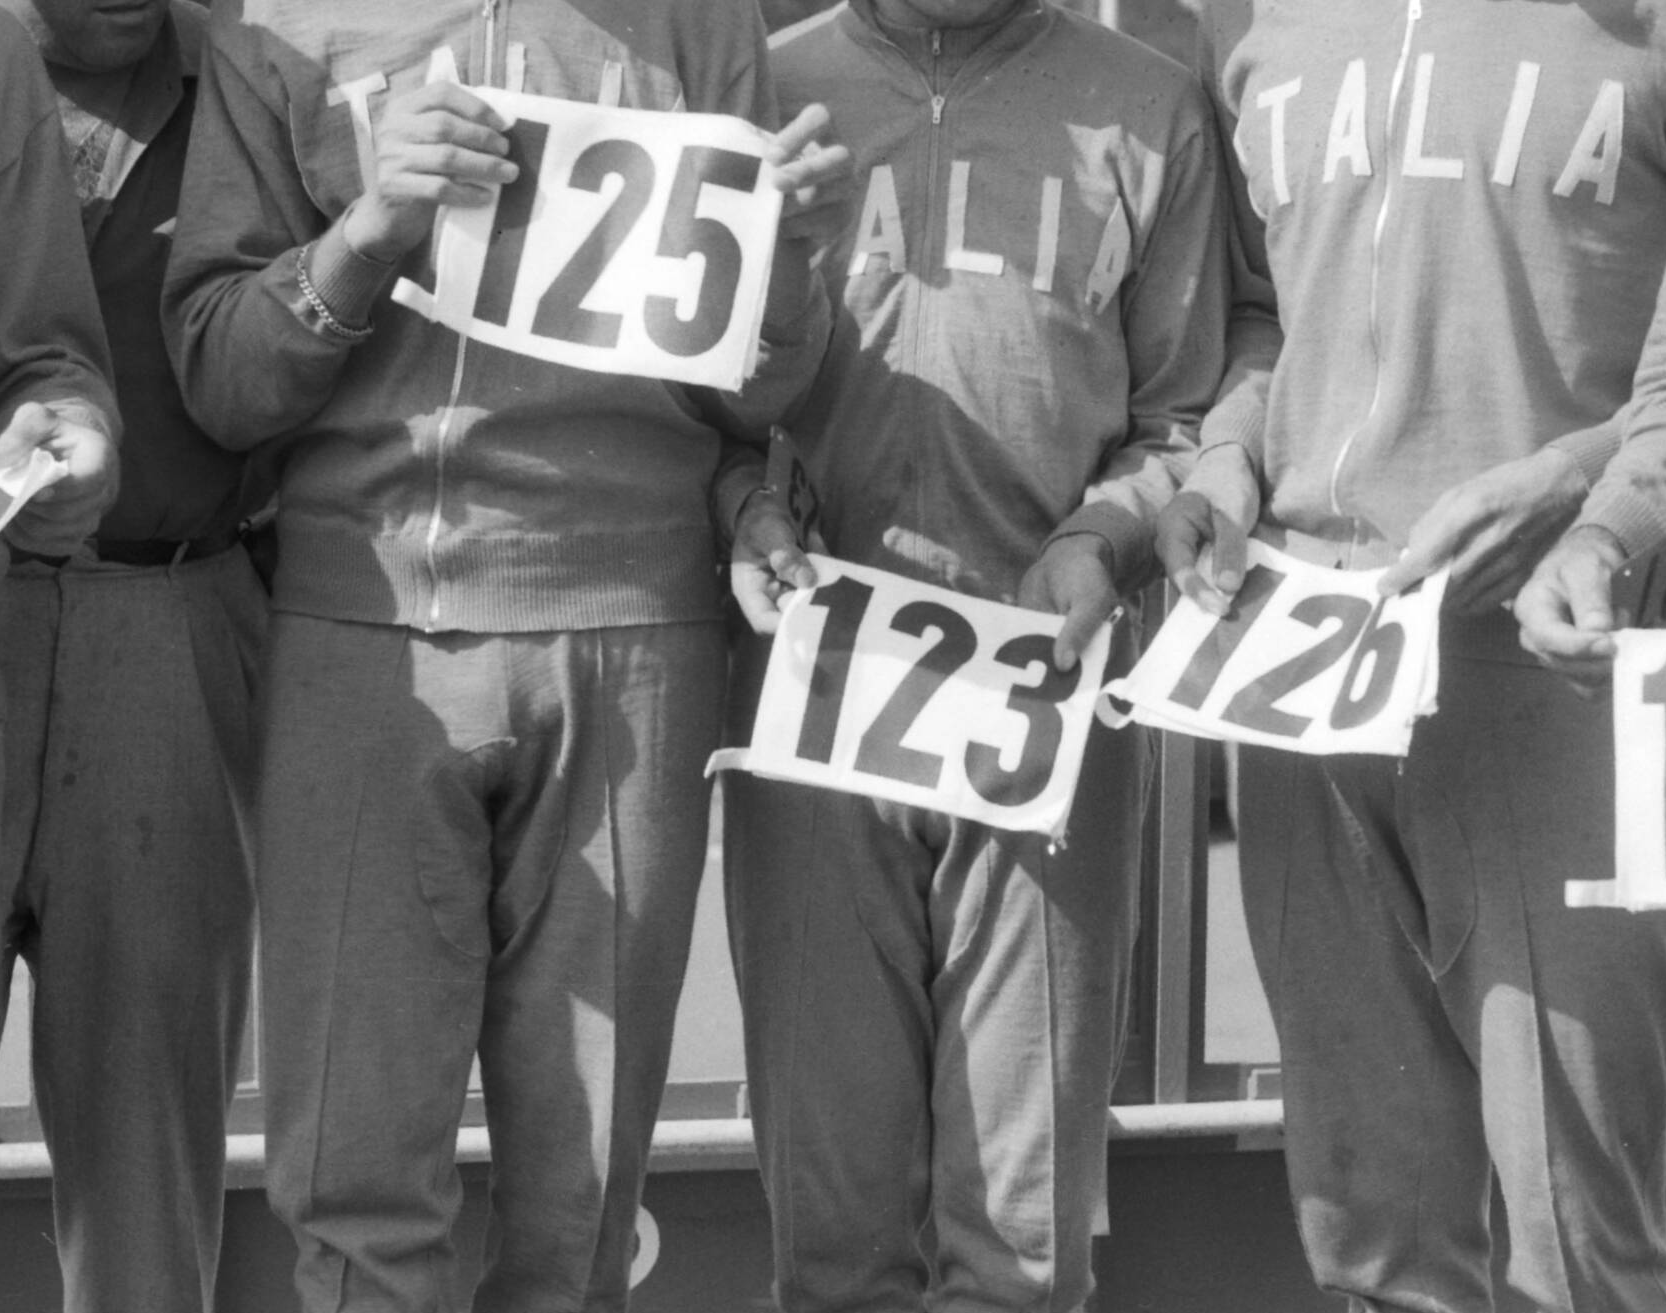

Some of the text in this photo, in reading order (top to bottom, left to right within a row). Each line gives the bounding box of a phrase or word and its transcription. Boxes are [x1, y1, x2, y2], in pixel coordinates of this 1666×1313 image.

[1235, 54, 1626, 208] TALIA
[472, 117, 764, 358] 125
[847, 160, 1133, 316] ALIA
[794, 574, 1083, 808] 123
[1167, 563, 1408, 740] 126
